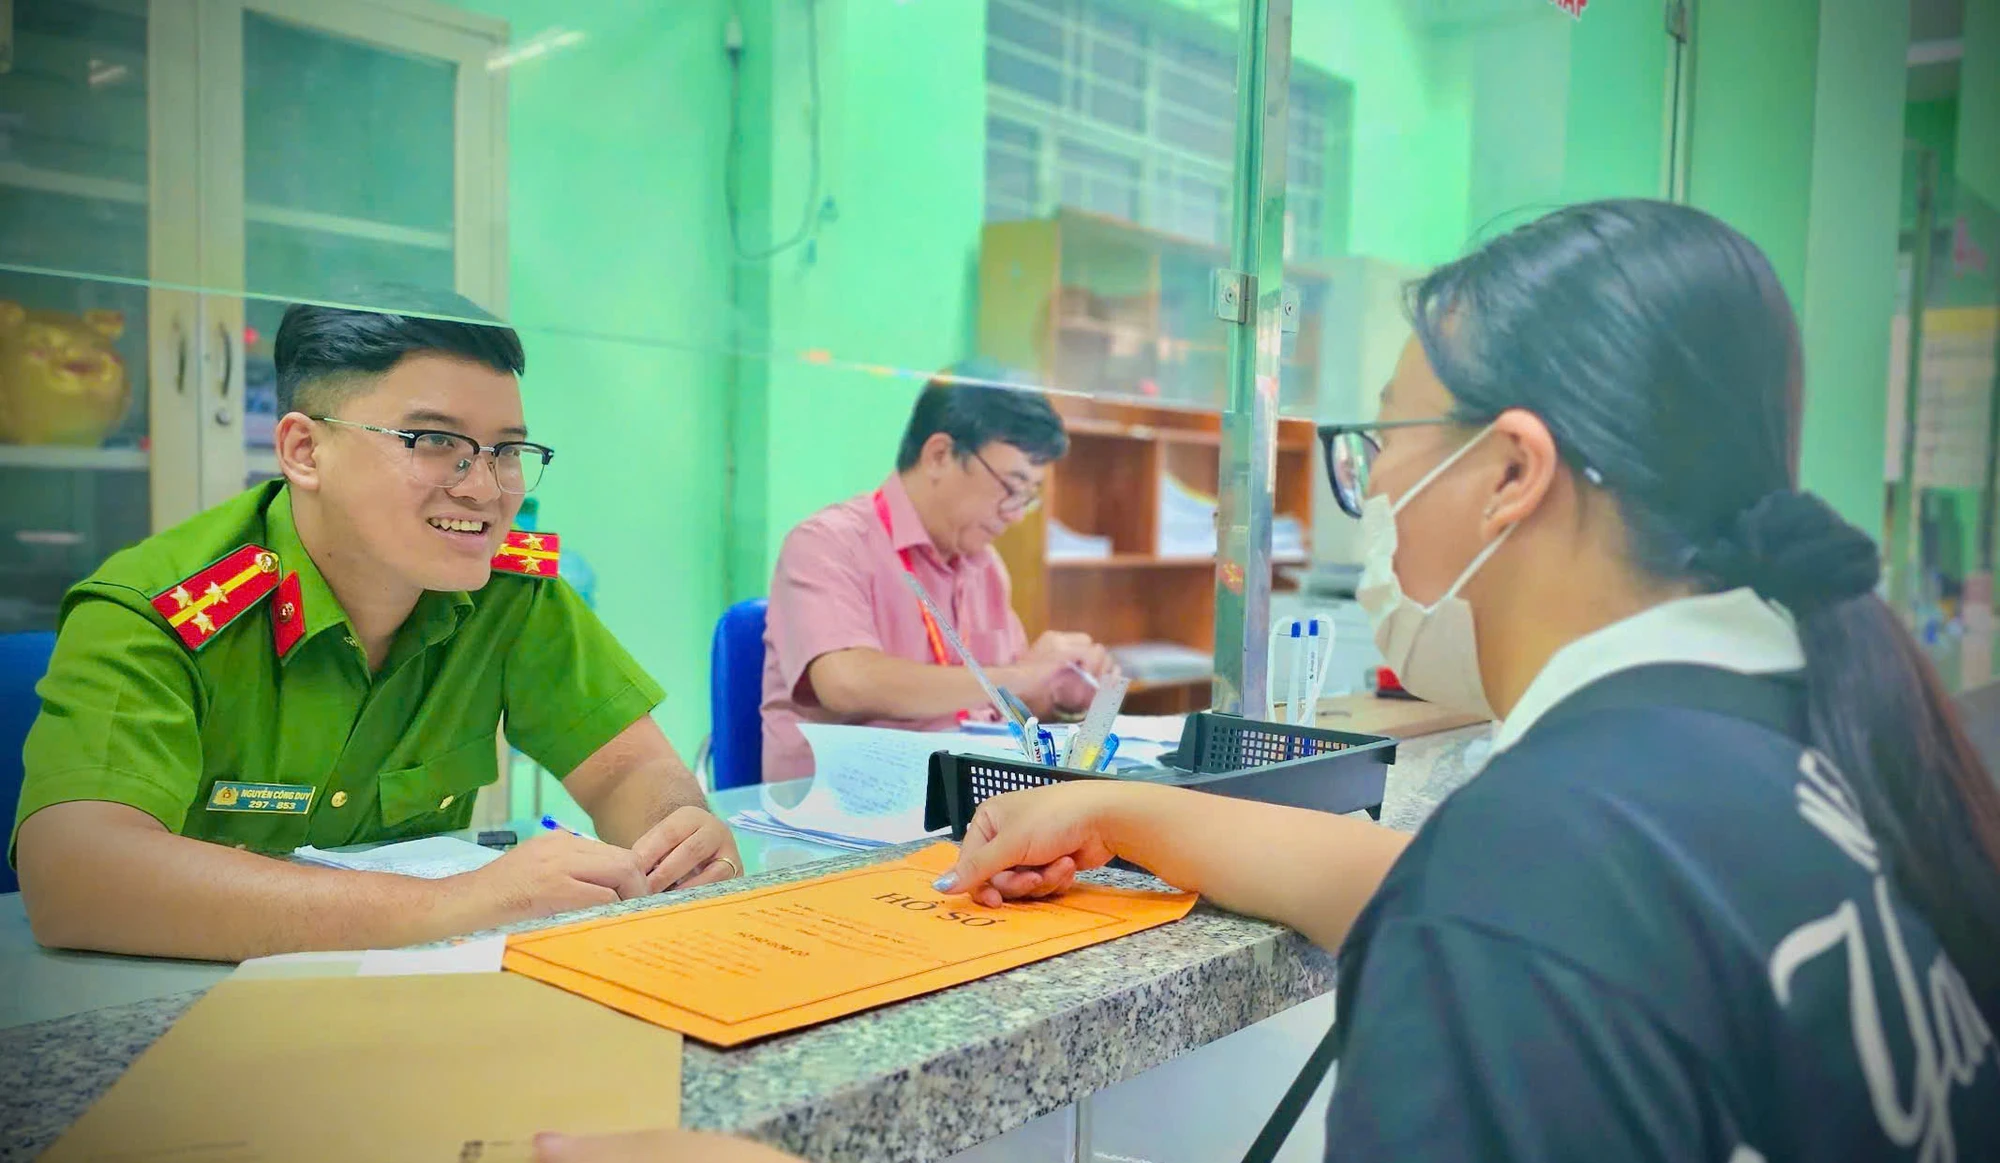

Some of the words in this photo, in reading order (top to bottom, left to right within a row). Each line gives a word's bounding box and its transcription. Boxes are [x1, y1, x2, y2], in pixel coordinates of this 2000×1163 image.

[294, 792, 311, 800] DUY
[248, 801, 269, 809] 297
[276, 802, 296, 810] 853
[871, 893, 945, 910] HỒ
[936, 912, 1006, 926] SƠ
